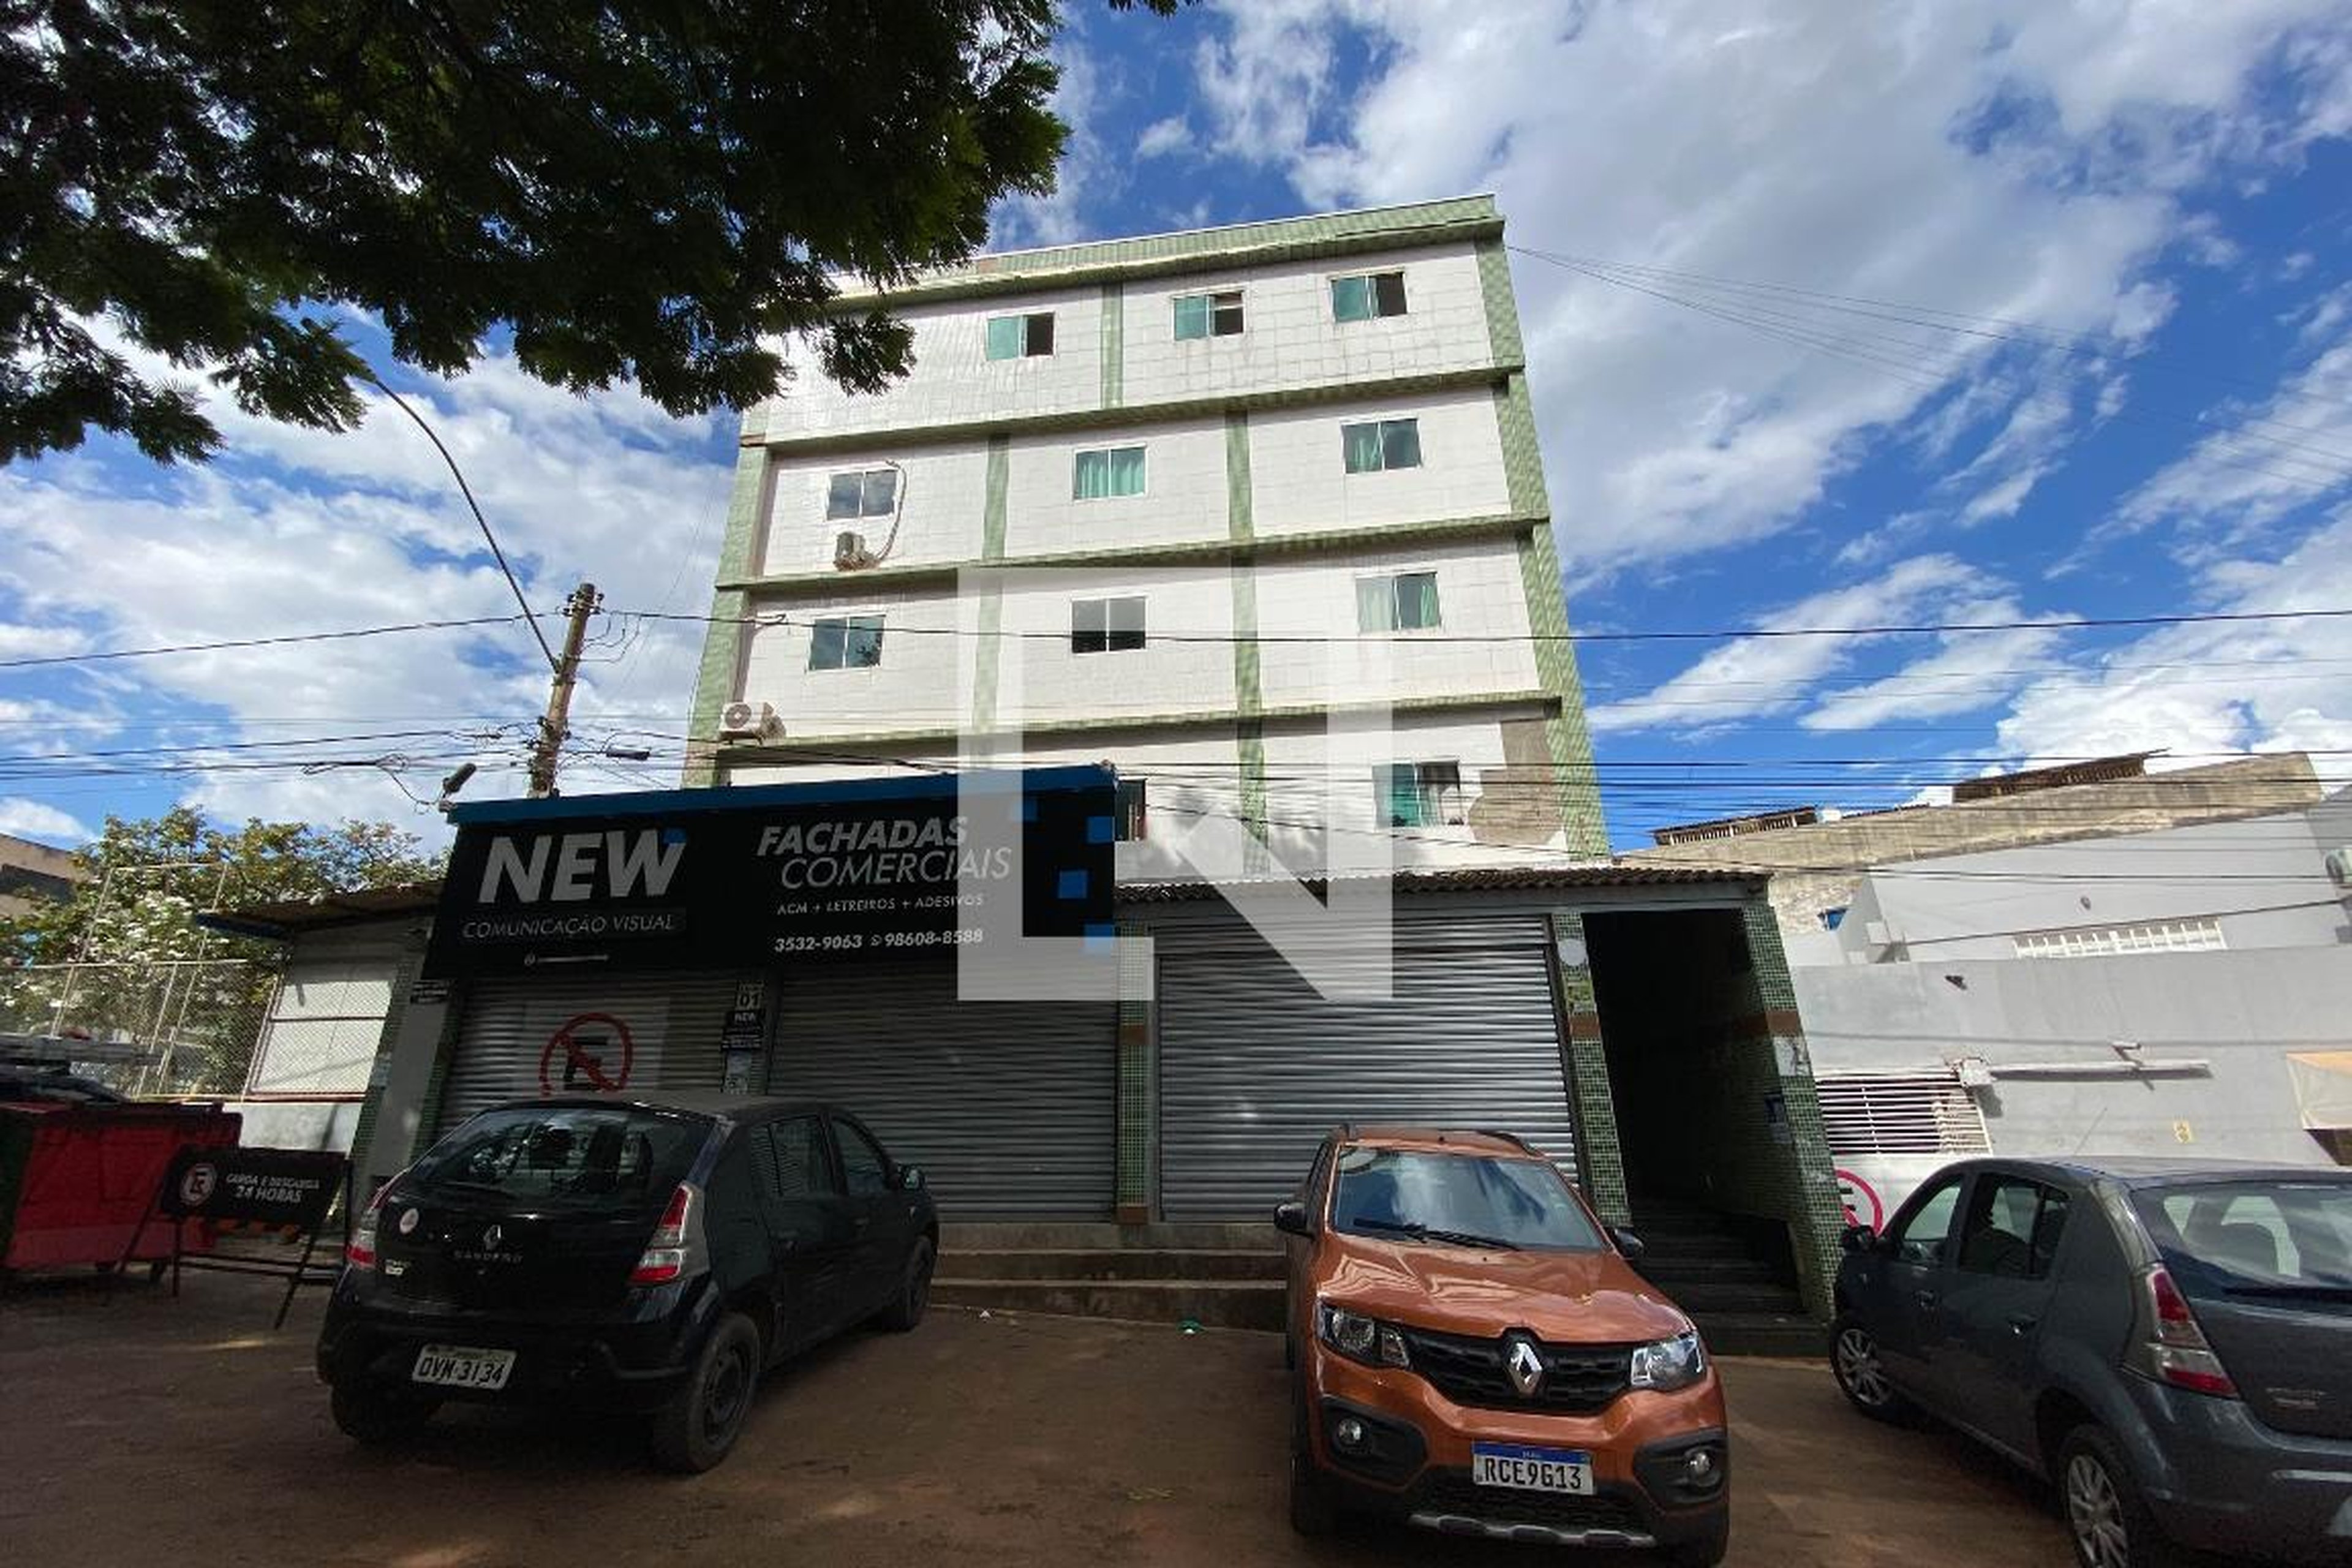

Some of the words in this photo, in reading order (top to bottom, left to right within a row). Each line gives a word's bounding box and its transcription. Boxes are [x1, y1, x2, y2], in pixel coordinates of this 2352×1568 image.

[757, 816, 969, 857] FACHADAS
[478, 829, 687, 903] NEW
[781, 848, 1013, 889] COMERCIAIS
[777, 902, 808, 915] ACM
[826, 897, 896, 912] LETREIROS
[914, 894, 984, 908] ADESIVOS
[612, 913, 675, 932] VISUAL
[774, 935, 862, 952] 3532-9063
[1485, 1458, 1581, 1489] RCE9G13
